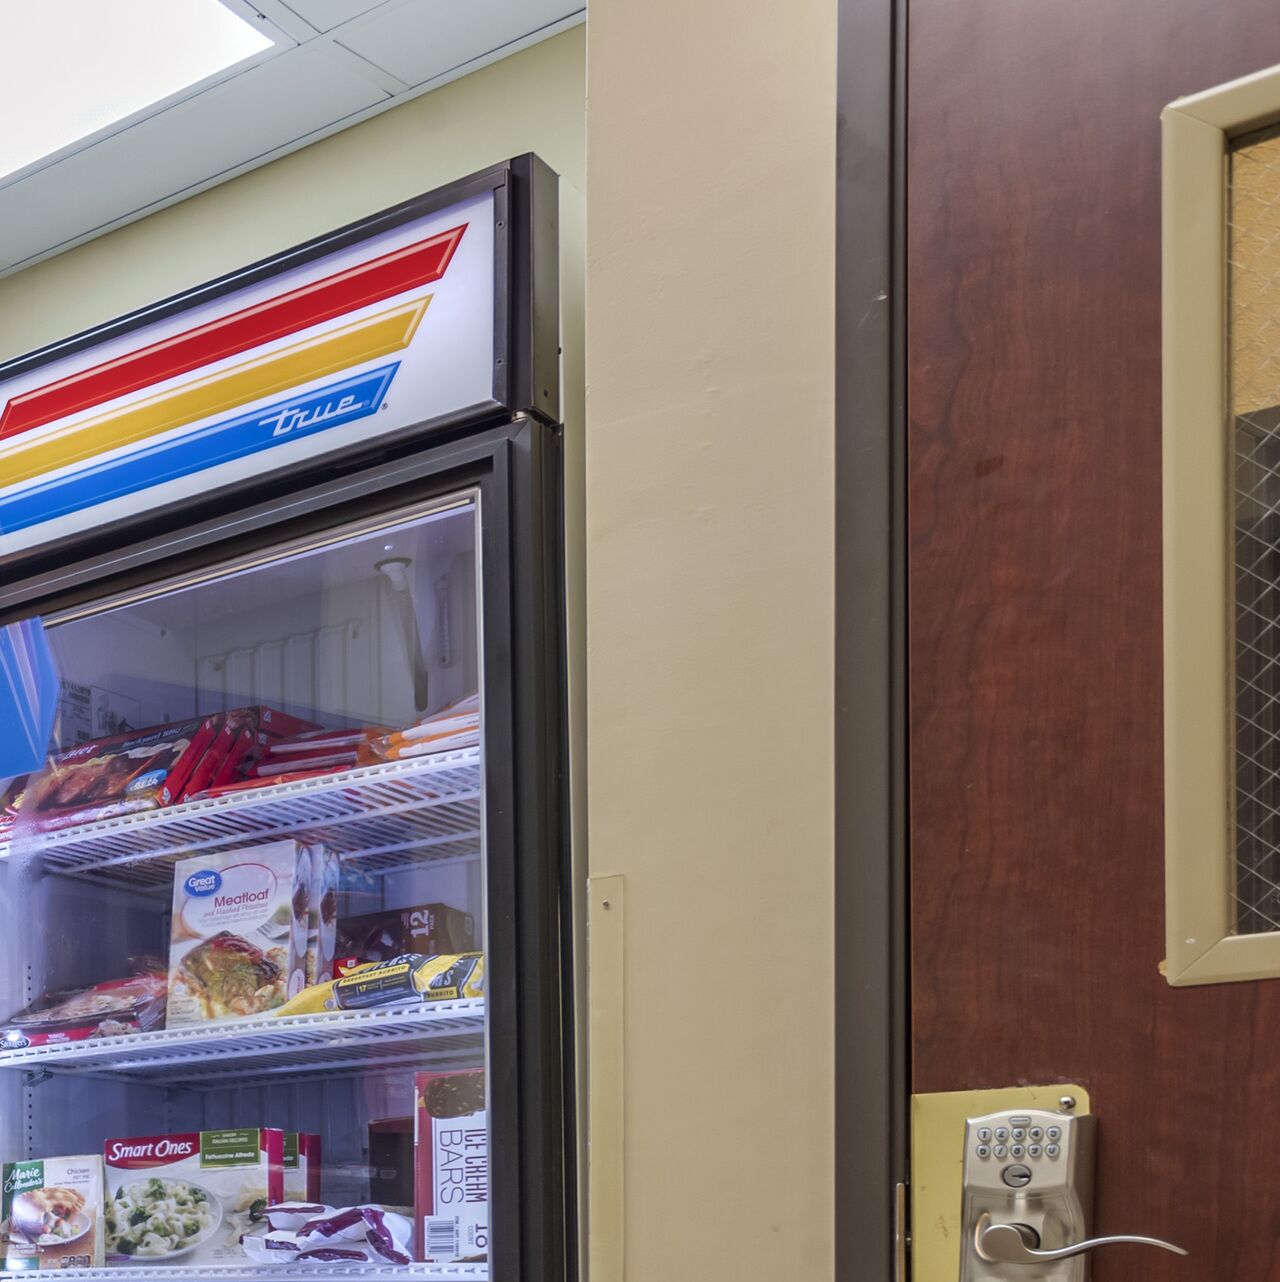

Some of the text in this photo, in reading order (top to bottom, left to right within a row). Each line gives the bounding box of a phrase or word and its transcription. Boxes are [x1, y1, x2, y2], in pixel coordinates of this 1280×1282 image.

[258, 392, 364, 437] true
[189, 875, 215, 887] Great
[214, 888, 269, 908] Meatloaf
[410, 910, 429, 938] 12
[426, 990, 454, 998] BURRITO
[108, 1139, 193, 1161] Smart Ones
[205, 1151, 255, 1161] Fettuccine Alfredo
[440, 1129, 464, 1204] BARS
